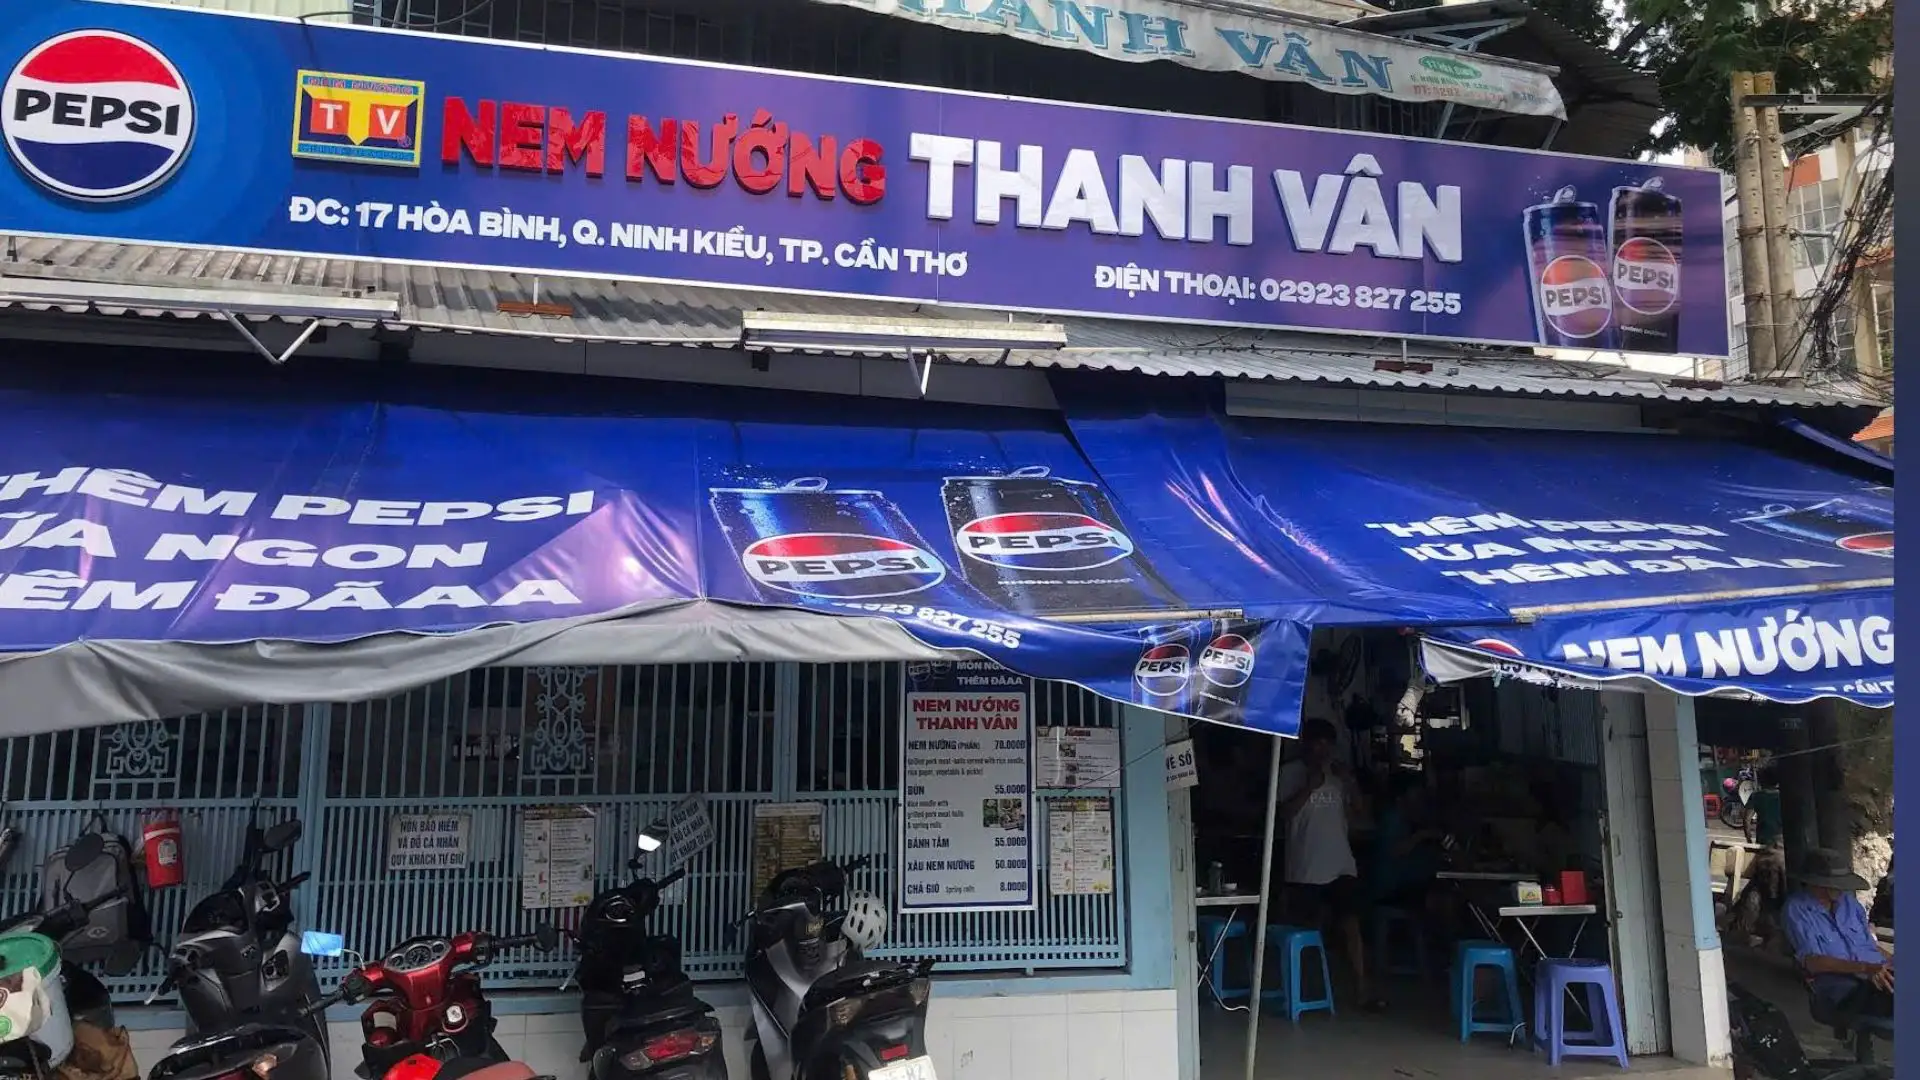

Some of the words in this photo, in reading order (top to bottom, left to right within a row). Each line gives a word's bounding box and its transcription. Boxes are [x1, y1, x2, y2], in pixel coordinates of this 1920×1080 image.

[1215, 27, 1393, 93] VÂN
[14, 88, 180, 136] PEPSI
[319, 103, 343, 130] T
[376, 107, 401, 135] V
[441, 96, 606, 178] NEM
[626, 107, 886, 206] NƯỚNG
[909, 131, 1253, 246] THANH
[1272, 153, 1463, 264] VÂN
[289, 196, 349, 226] ĐC:
[355, 202, 394, 228] 17
[398, 200, 473, 235] HÒA
[478, 207, 567, 248] BÌNH,
[572, 219, 605, 246] Q.
[610, 221, 688, 254] NINH
[693, 225, 774, 266] KIỀU,
[779, 237, 829, 265] TP.
[834, 237, 899, 271] CẦN
[903, 248, 968, 277] THƠ
[1095, 262, 1159, 298] ĐIỆN
[1164, 271, 1255, 306] THOẠI:
[1260, 278, 1350, 307] 02923
[1354, 285, 1405, 310] 827
[1410, 290, 1462, 315] 255
[1618, 263, 1675, 289] PEPSI
[1546, 286, 1607, 307] PEPSI
[270, 490, 595, 526] PEPSI
[144, 533, 488, 569] NGON
[968, 532, 1121, 550] PEPSI
[757, 556, 930, 576] PEPSI
[0, 568, 198, 611] ÊM
[215, 580, 583, 611] ĐÃAA
[917, 607, 969, 631] 827
[968, 618, 1022, 649] 255
[1695, 608, 1894, 679] NƯỚNG
[1138, 661, 1186, 673] PEPSI
[1203, 648, 1251, 671] PEPSI
[913, 699, 951, 712] NEM
[955, 696, 1020, 712] NƯỚNG
[916, 717, 978, 730] THANH
[981, 714, 1018, 730] VÂN
[908, 740, 927, 750] NEM
[907, 784, 925, 796] BÚN
[907, 837, 930, 849] BÁNH
[926, 860, 944, 871] NEM
